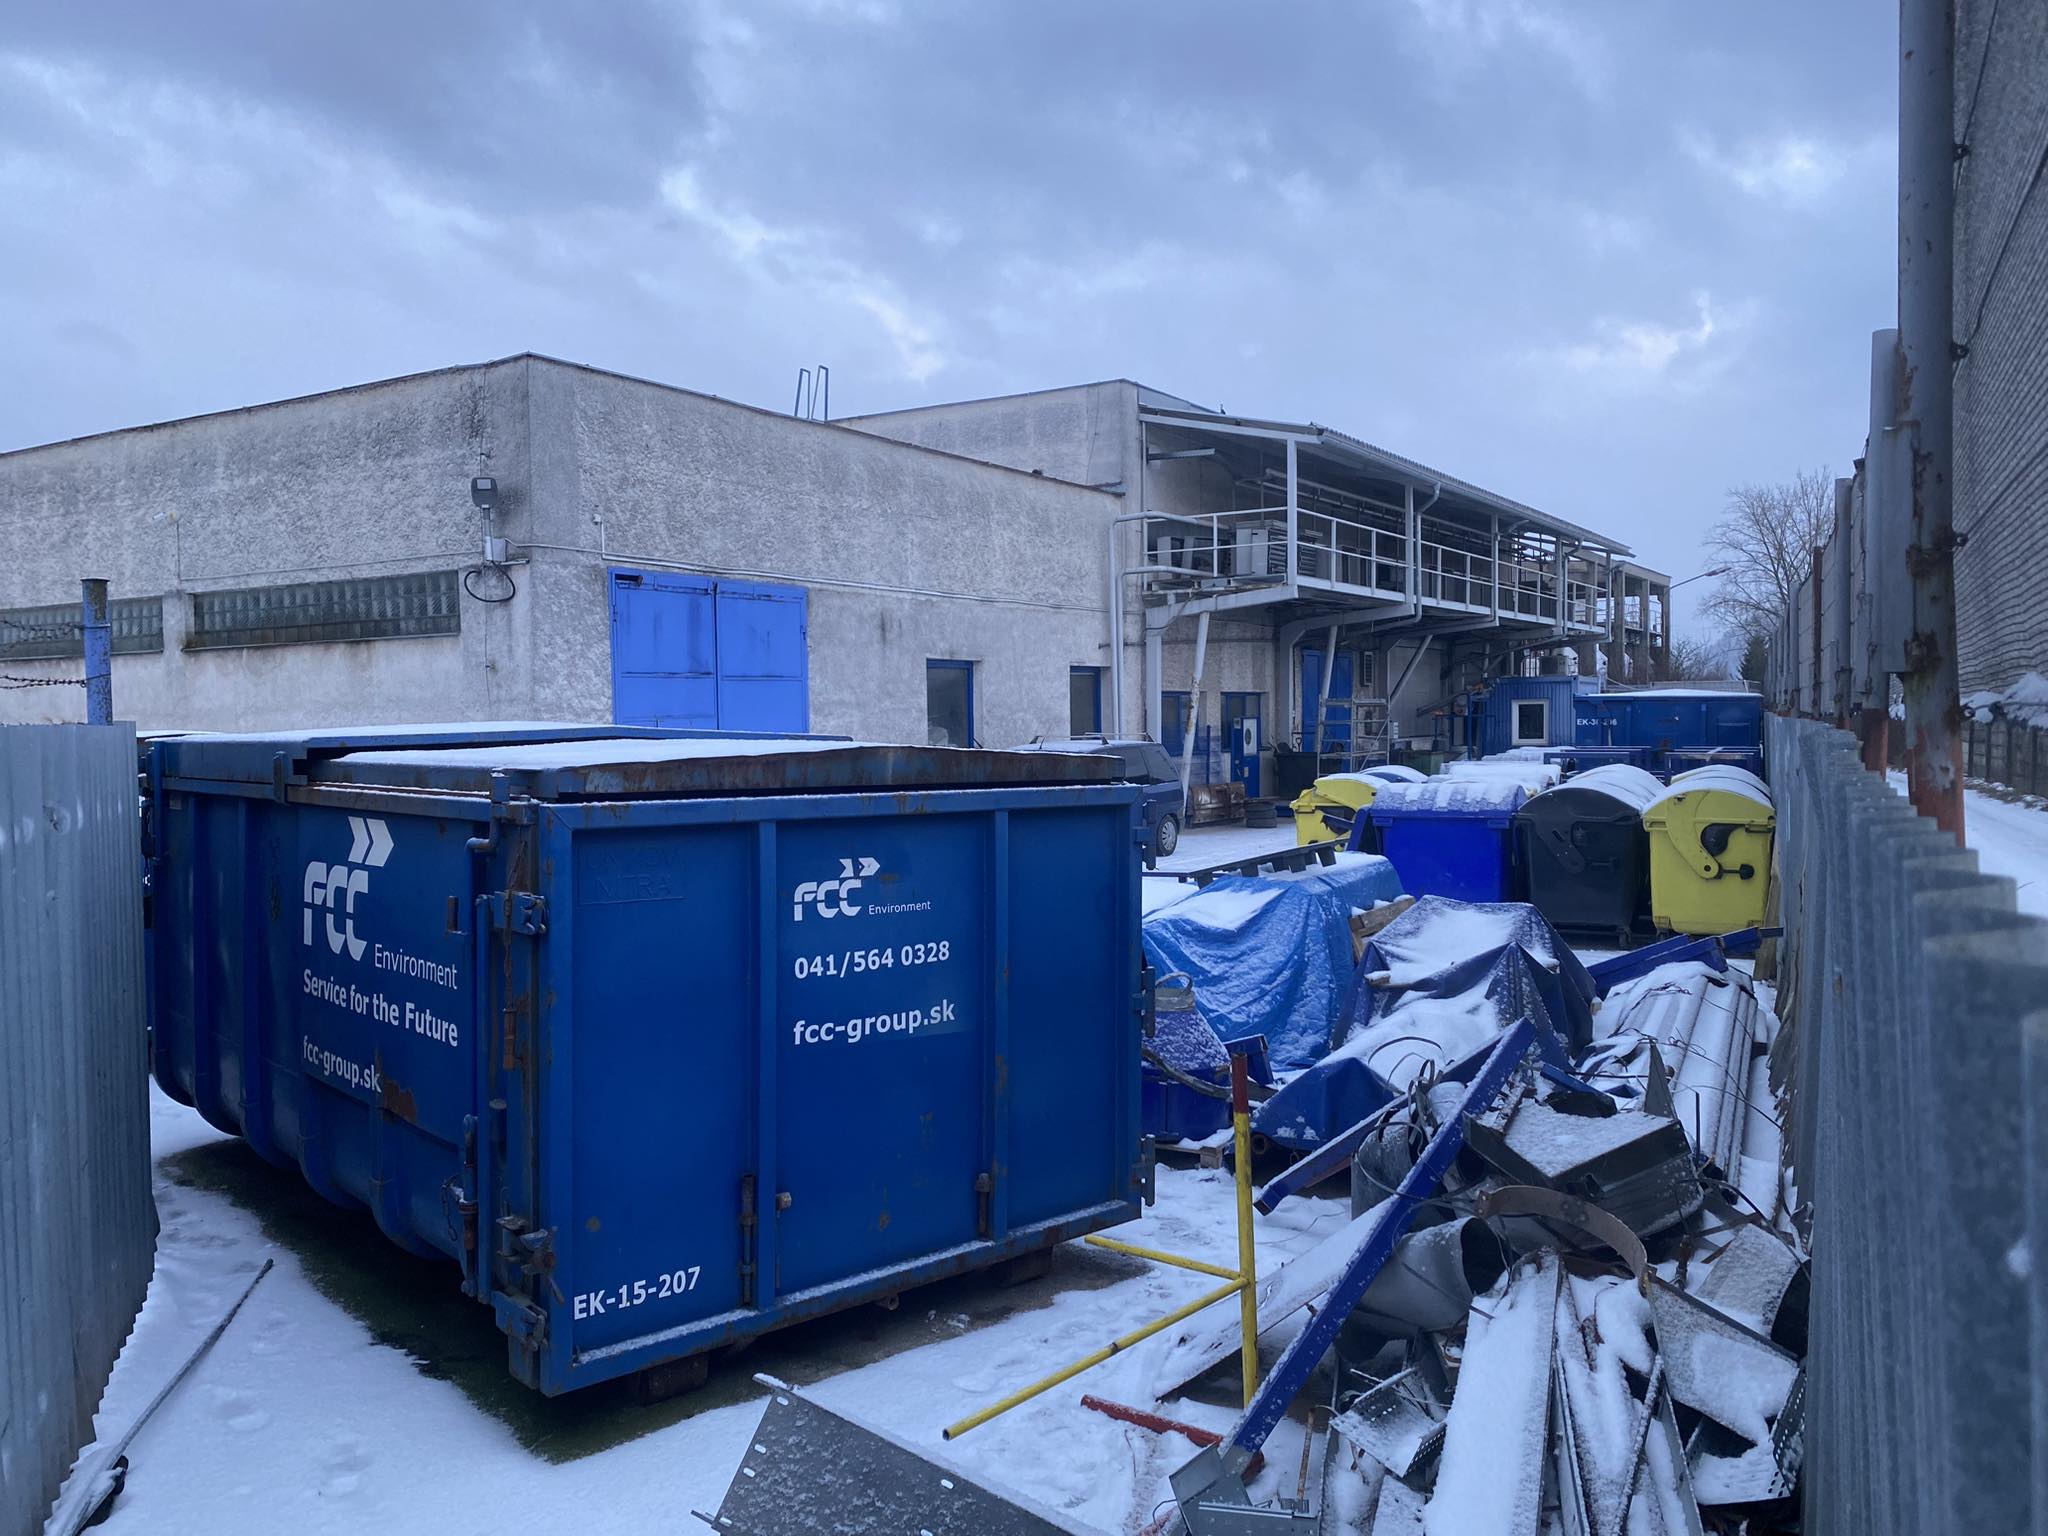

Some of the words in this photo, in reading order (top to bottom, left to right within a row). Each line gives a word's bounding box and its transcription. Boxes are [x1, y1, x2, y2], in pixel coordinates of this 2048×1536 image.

[303, 861, 369, 962] FCC
[793, 879, 862, 921] FCC
[869, 901, 932, 915] Environment
[373, 944, 458, 990] Environment
[794, 948, 894, 979] 041/564
[901, 940, 950, 966] 0328
[303, 968, 347, 1008] Service
[349, 984, 370, 1015] for
[372, 993, 399, 1026] the
[405, 1001, 458, 1047] Future
[793, 999, 955, 1045] fcc-group.sk
[303, 1035, 382, 1093] fcc-group.sk
[573, 1265, 701, 1321] EK-15-207
